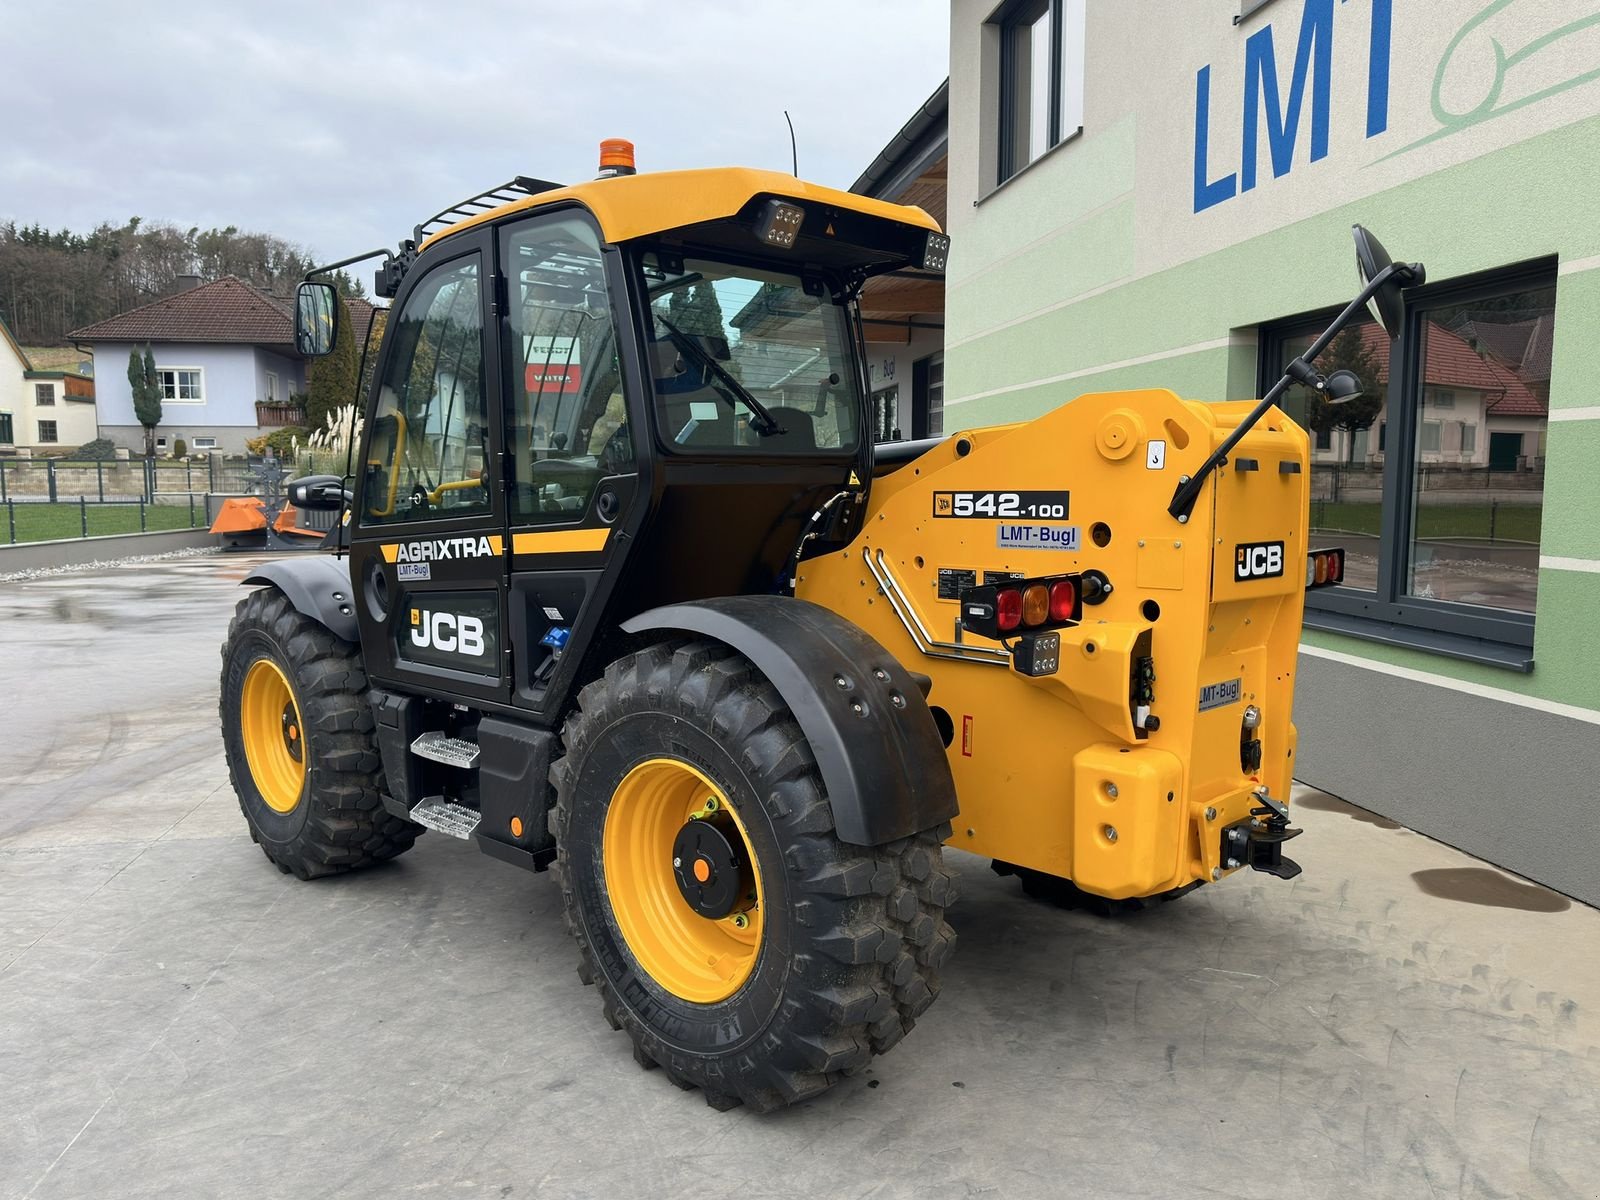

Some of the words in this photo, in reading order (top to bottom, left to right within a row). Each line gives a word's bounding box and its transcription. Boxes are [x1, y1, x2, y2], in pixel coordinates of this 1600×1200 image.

[1194, 0, 1393, 214] LMT
[397, 536, 493, 562] AGRIXTRA
[1000, 526, 1076, 546] LMT-Bugl
[399, 563, 429, 577] LMT-Bugl
[1238, 545, 1282, 577] JCB
[411, 609, 485, 657] JCB
